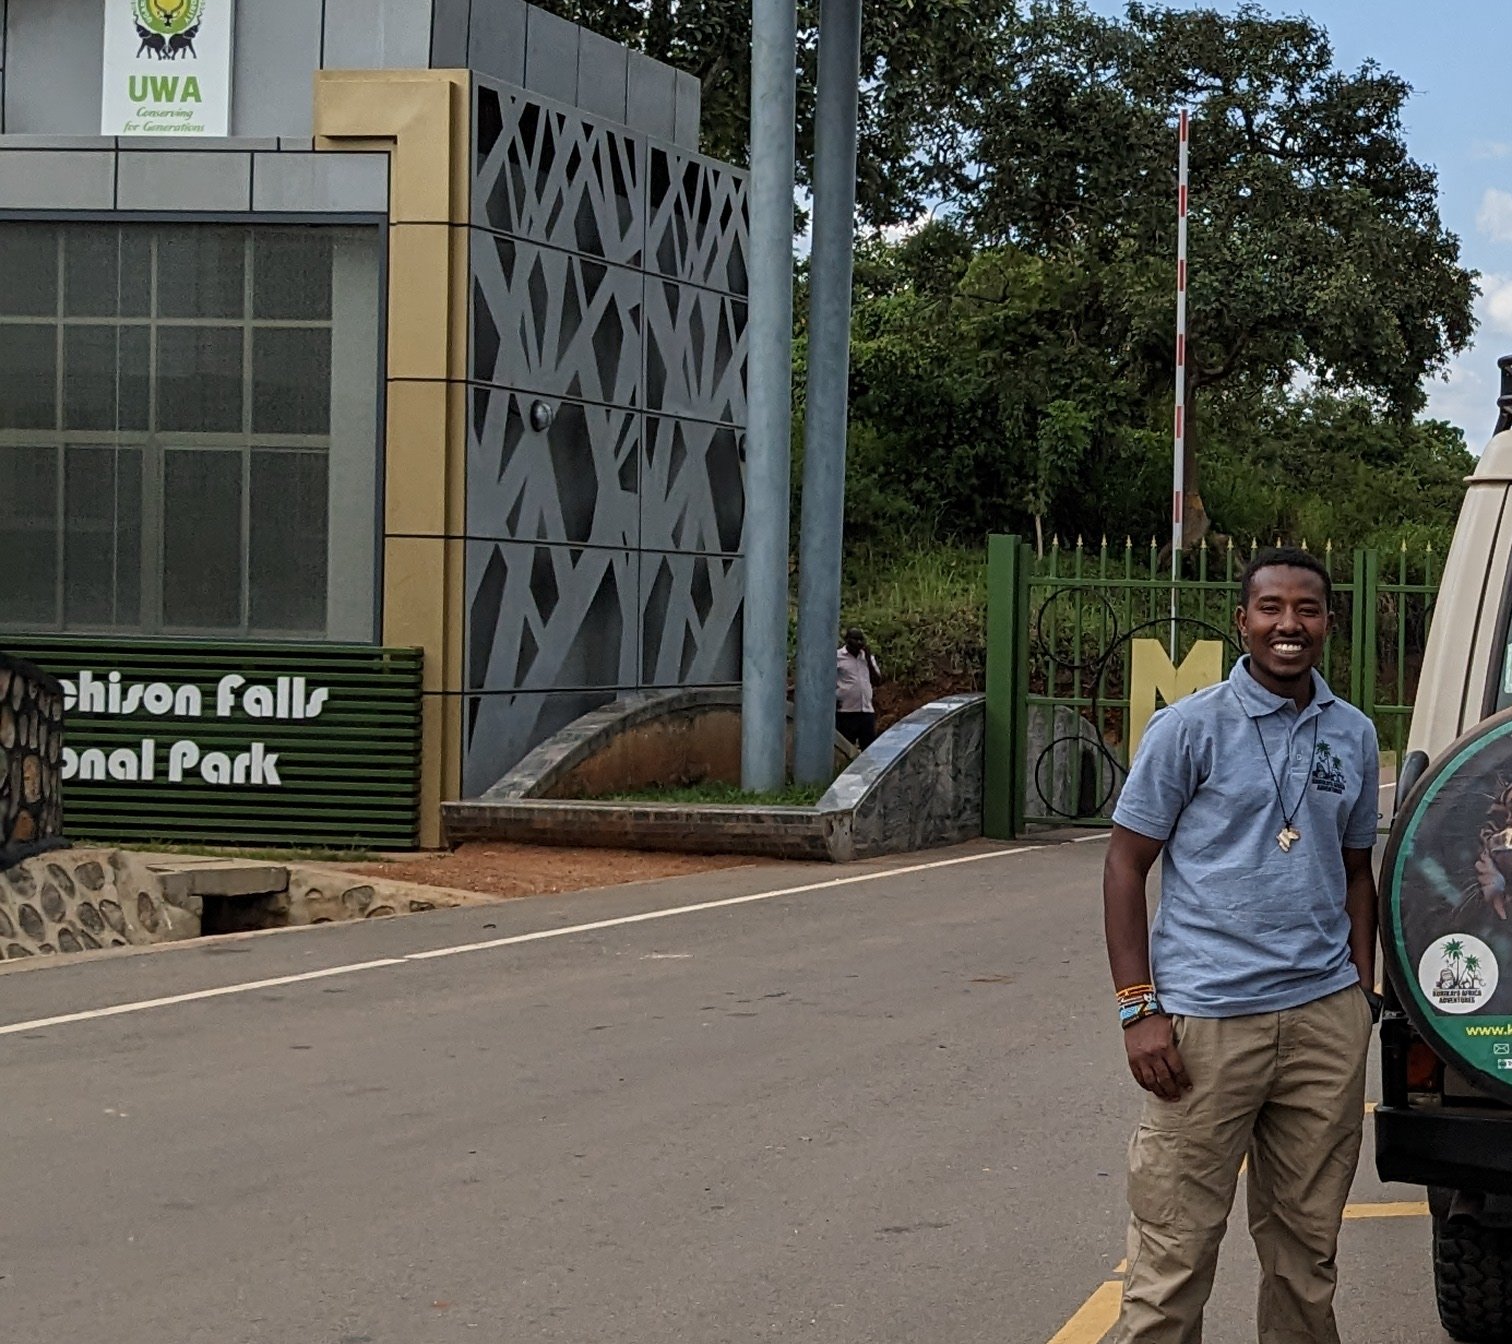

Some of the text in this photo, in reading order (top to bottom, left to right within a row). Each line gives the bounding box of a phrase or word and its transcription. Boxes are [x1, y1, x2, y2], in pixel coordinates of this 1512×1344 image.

[128, 75, 202, 103] UWA
[123, 120, 205, 133] for Generations
[136, 107, 193, 121] Conserving
[216, 673, 329, 719] Falls
[168, 739, 282, 786] Park
